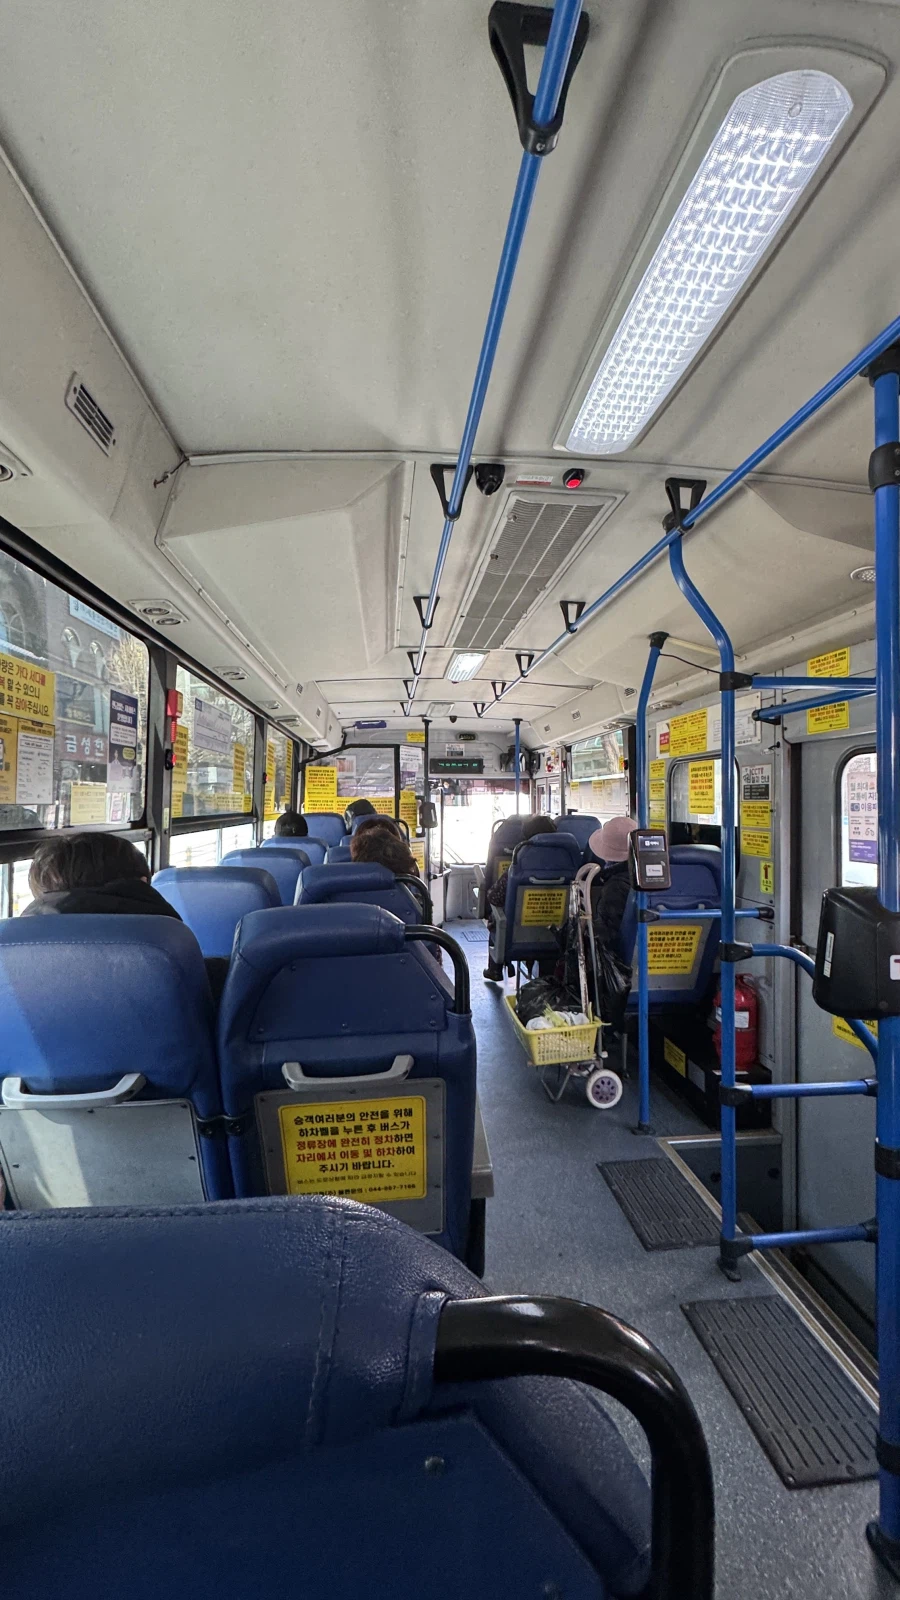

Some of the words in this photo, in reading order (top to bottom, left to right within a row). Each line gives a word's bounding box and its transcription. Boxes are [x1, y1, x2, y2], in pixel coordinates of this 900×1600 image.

[16, 664, 28, 680] 가다
[15, 680, 21, 693] 수
[294, 1112, 356, 1126] 승객여러분의
[359, 1109, 390, 1121] 안전을
[393, 1107, 413, 1118] 위해
[298, 1125, 340, 1138] 하차벨을
[343, 1124, 363, 1136] 누른
[367, 1123, 377, 1133] 후
[380, 1120, 410, 1132] 버스가
[296, 1137, 337, 1151] 정류장에
[340, 1136, 371, 1148] 완전히
[373, 1132, 414, 1145] 정차하면
[296, 1149, 336, 1164] 자리에서
[339, 1148, 360, 1160] 이동
[363, 1147, 373, 1158] 및
[375, 1145, 416, 1157] 하차하여
[319, 1161, 349, 1174] 주시기
[352, 1159, 395, 1171] 바랍니다.
